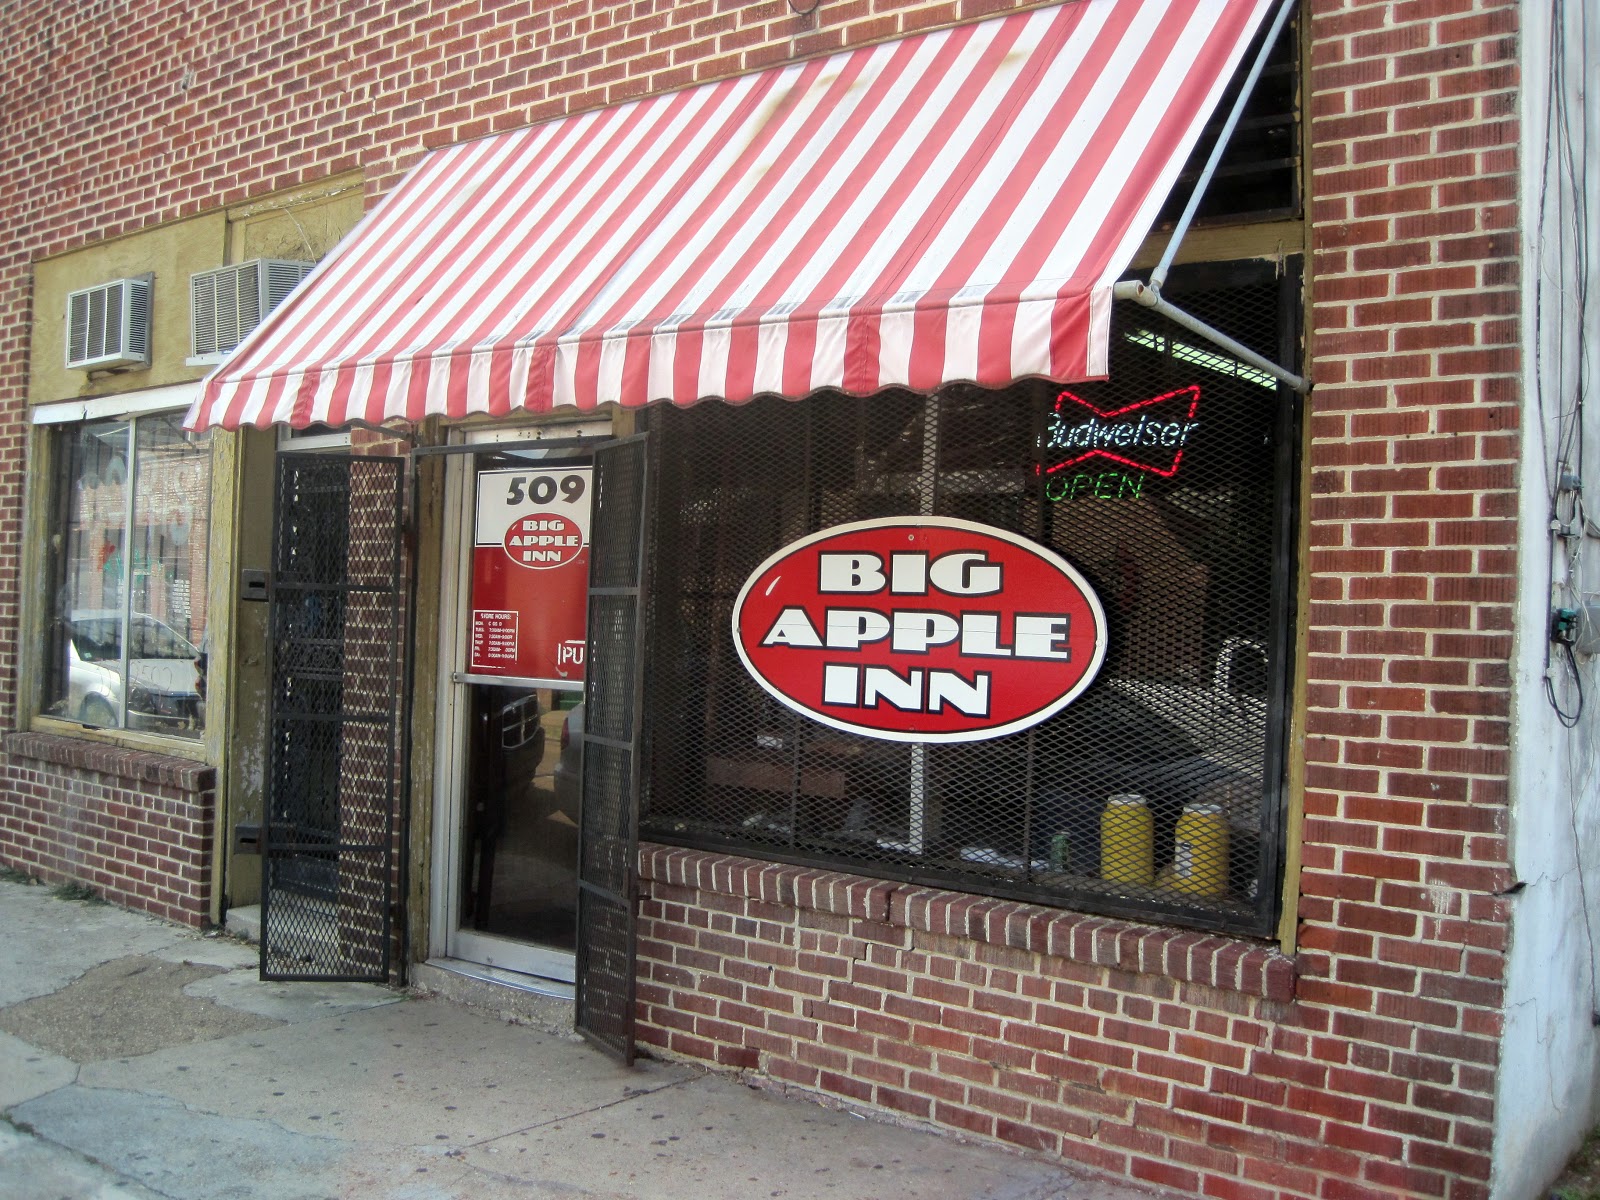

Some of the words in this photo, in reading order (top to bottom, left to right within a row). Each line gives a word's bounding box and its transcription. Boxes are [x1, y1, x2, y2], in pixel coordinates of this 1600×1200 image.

[1036, 411, 1200, 448] Budweiser
[506, 474, 586, 506] 509
[1045, 472, 1146, 502] OPEN
[508, 535, 580, 547] APPLE
[522, 519, 566, 532] BIG
[522, 550, 562, 562] INN
[818, 550, 1004, 598] BIG
[758, 605, 1071, 662] APPLE
[822, 662, 991, 719] INN
